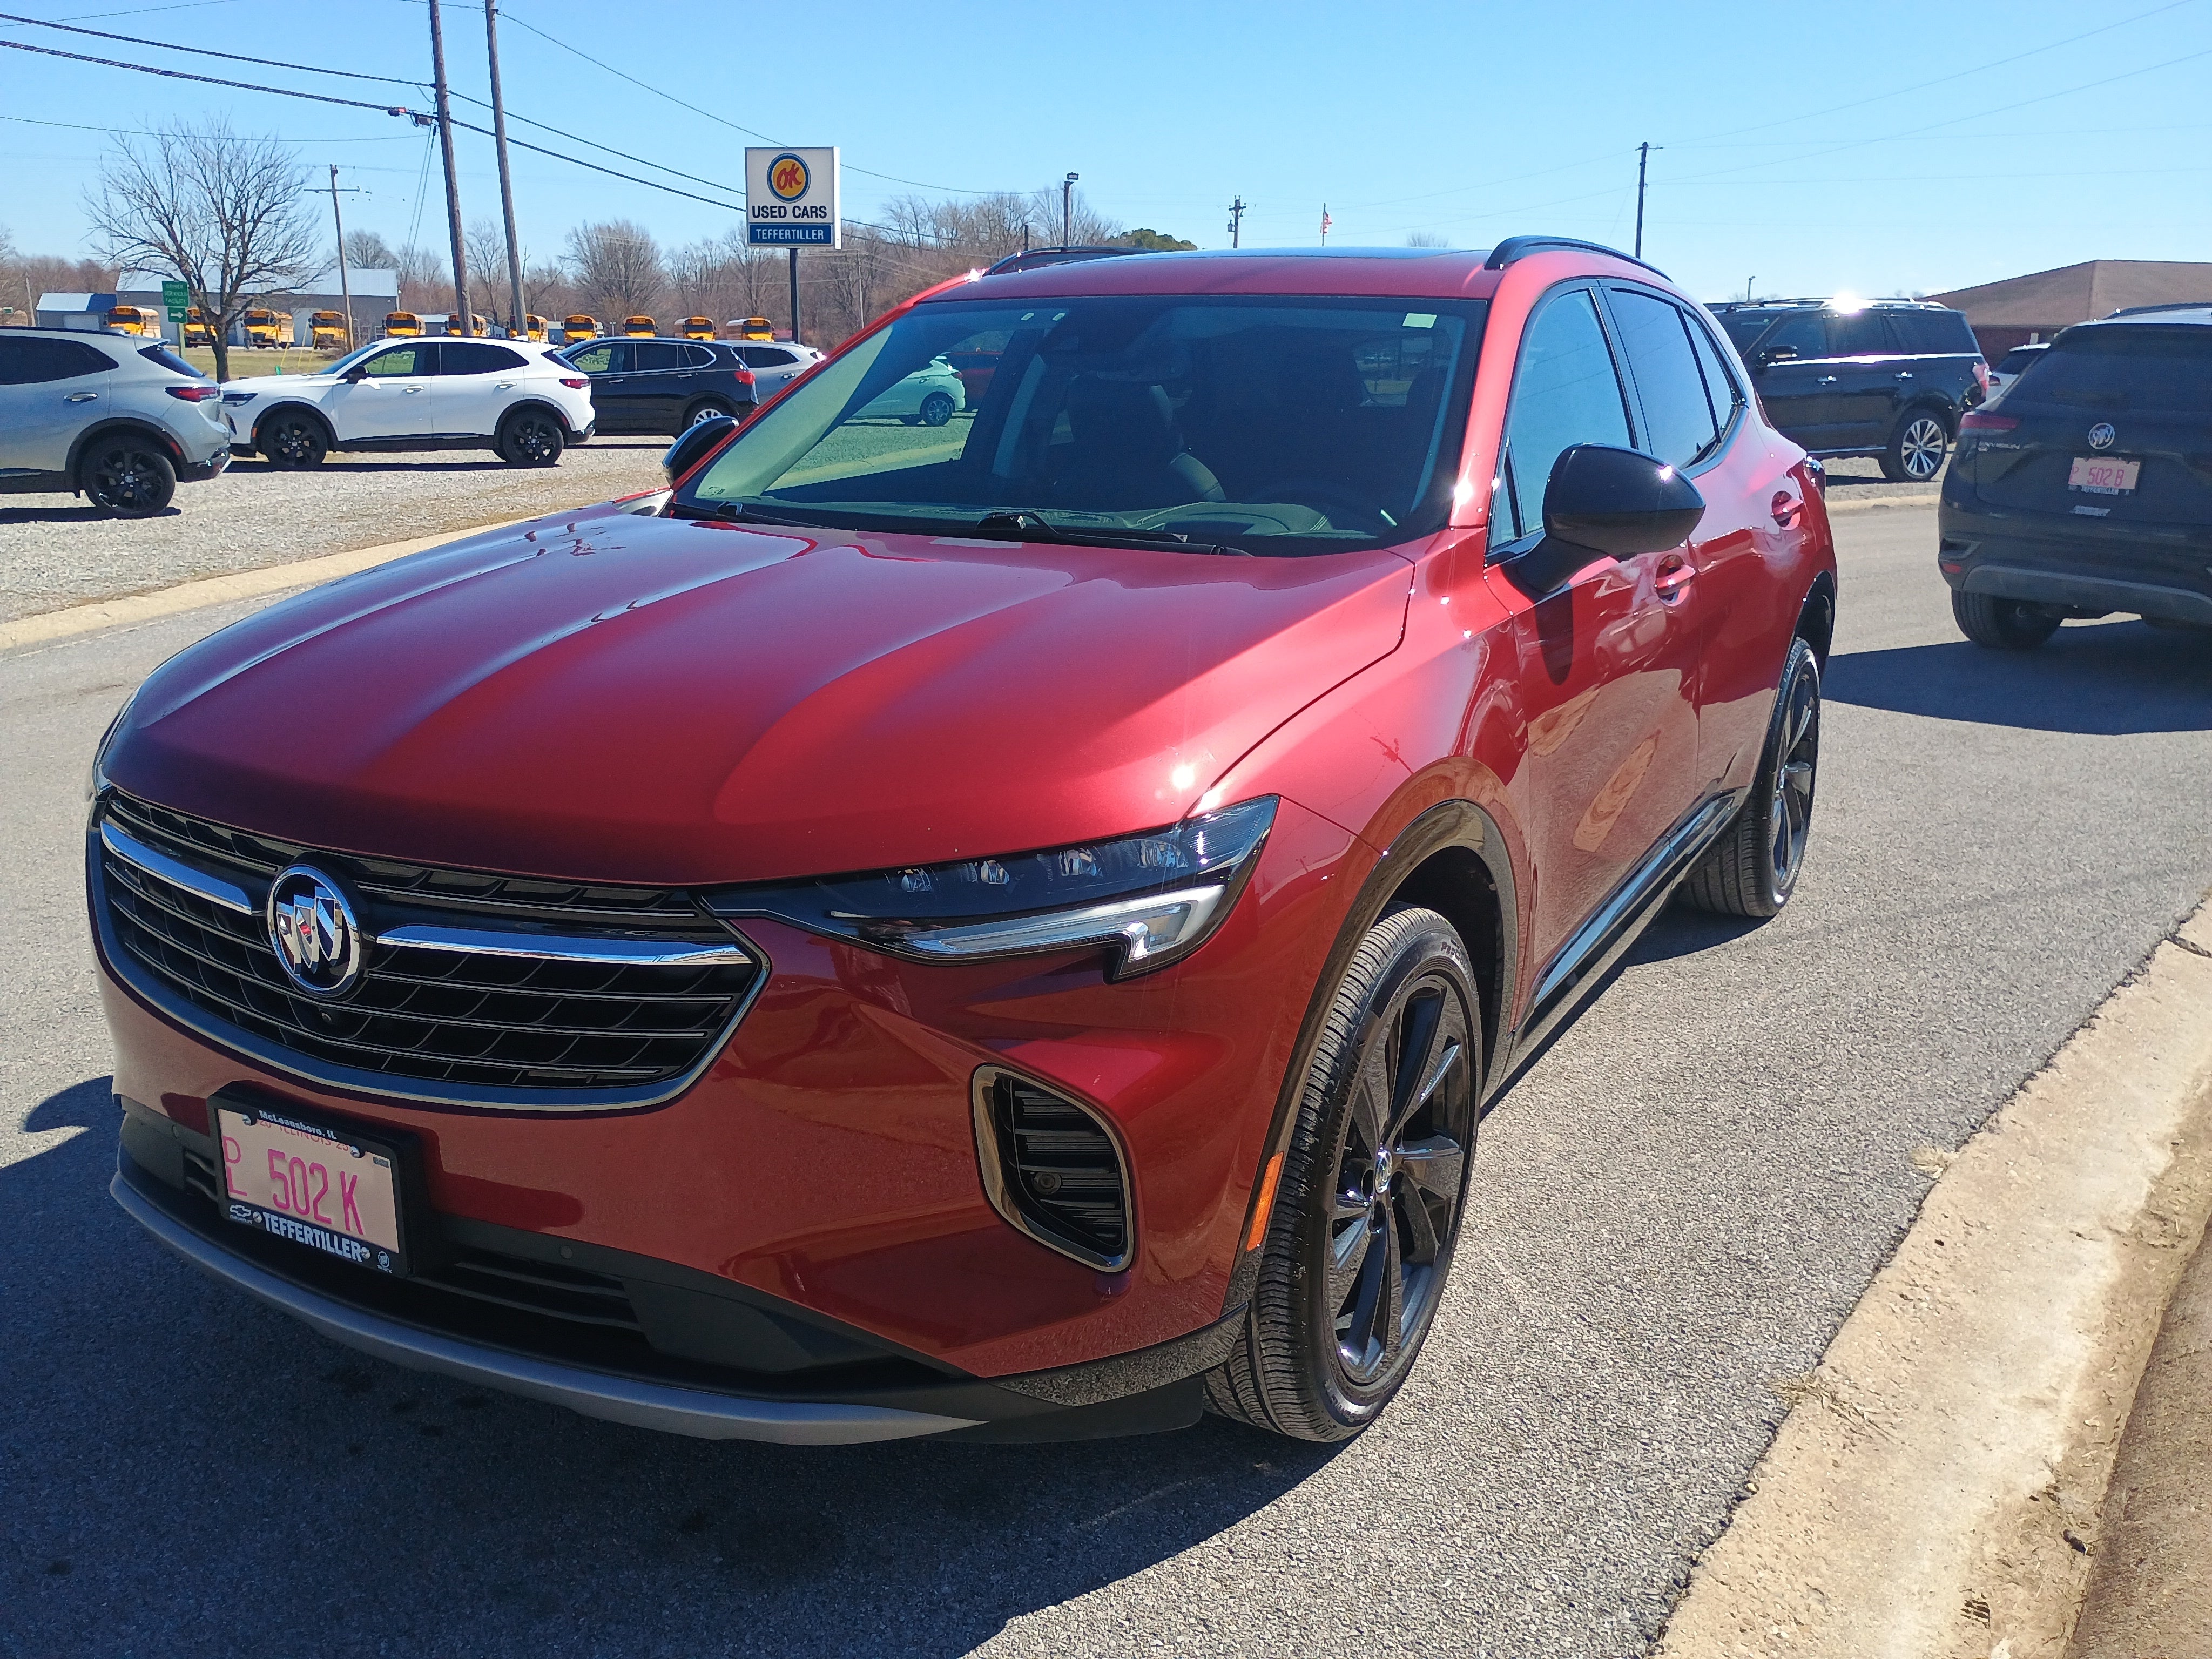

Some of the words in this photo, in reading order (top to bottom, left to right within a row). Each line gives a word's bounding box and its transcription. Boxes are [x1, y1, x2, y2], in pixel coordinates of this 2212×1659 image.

[777, 163, 802, 191] OK
[752, 205, 787, 218] USED
[792, 205, 827, 219] CARS
[756, 228, 824, 240] TEFFERTILLER
[2087, 467, 2113, 487] 502
[259, 1110, 325, 1137] McLeansboro,
[326, 1130, 338, 1140] IL
[267, 1148, 332, 1225] 502
[340, 1170, 364, 1236] K
[262, 1211, 363, 1263] TEFFERTILLER
